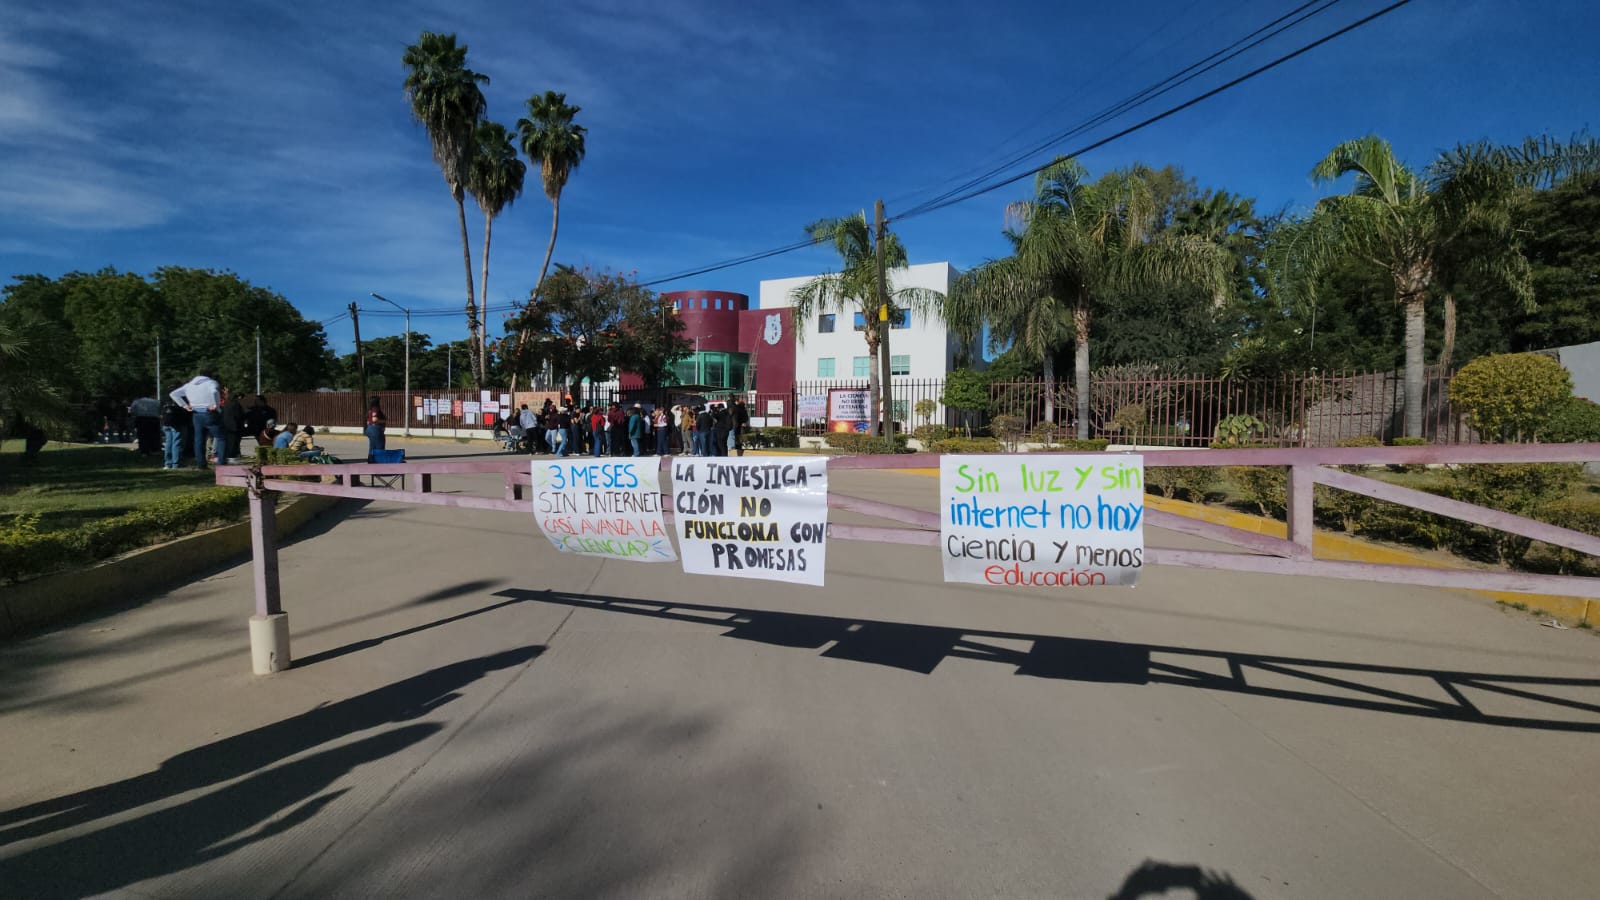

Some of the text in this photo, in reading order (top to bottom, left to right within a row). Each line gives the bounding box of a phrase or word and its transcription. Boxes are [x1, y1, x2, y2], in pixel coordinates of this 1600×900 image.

[549, 464, 638, 490] 3 MESES
[676, 464, 694, 482] LA
[956, 464, 999, 493] Sin
[1021, 464, 1064, 492] luz
[1102, 464, 1140, 490] sin
[539, 492, 659, 514] SIN INTERNET
[676, 488, 772, 517] CIÓN NO
[951, 494, 1144, 531] internet no hay
[581, 518, 640, 536] AVANZA
[640, 520, 666, 536] LA
[684, 520, 824, 543] FUNCIONA CON
[562, 536, 649, 558] CIENCIA?
[712, 543, 806, 571] PROMESAS
[1076, 545, 1142, 568] menos
[984, 563, 1106, 586] educación
